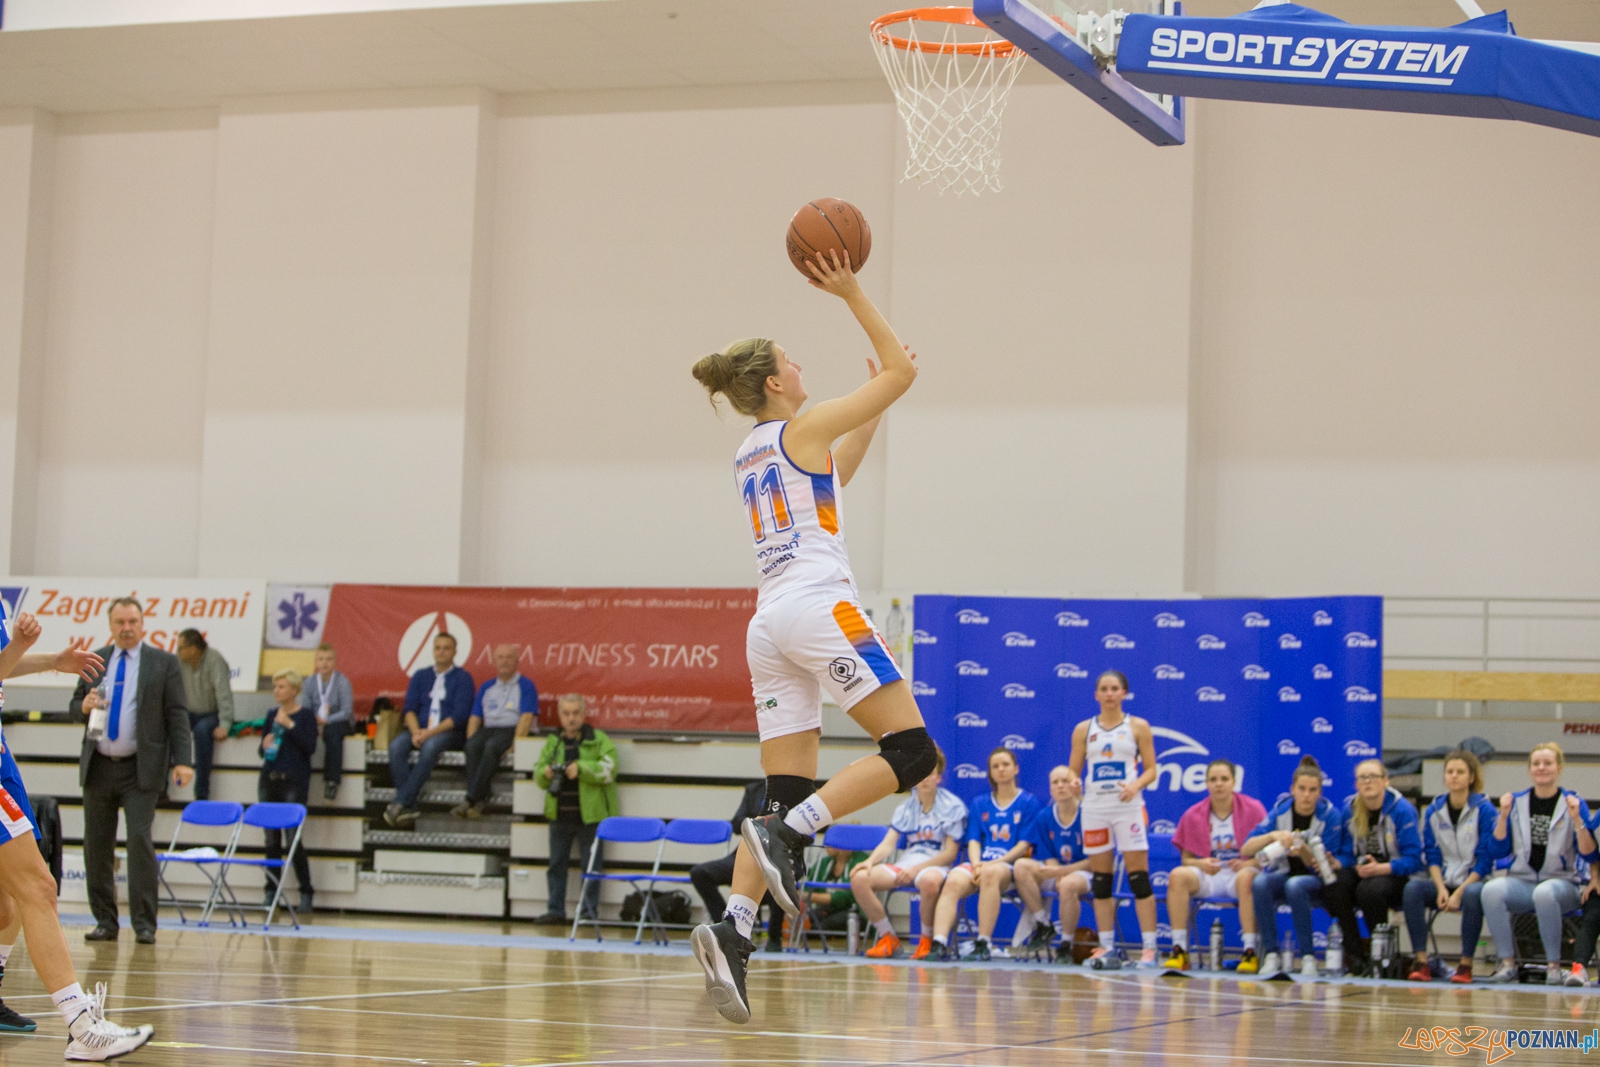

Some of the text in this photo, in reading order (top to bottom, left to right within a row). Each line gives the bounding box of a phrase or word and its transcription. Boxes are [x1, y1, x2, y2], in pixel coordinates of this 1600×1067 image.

[1150, 27, 1470, 79] SPORTSYSTEM
[743, 462, 794, 544] 11
[143, 598, 162, 618] z
[168, 592, 251, 618] nami
[544, 642, 637, 667] FITNESS
[646, 643, 720, 669] STARS
[1101, 743, 1113, 758] 4
[989, 823, 1011, 842] 14
